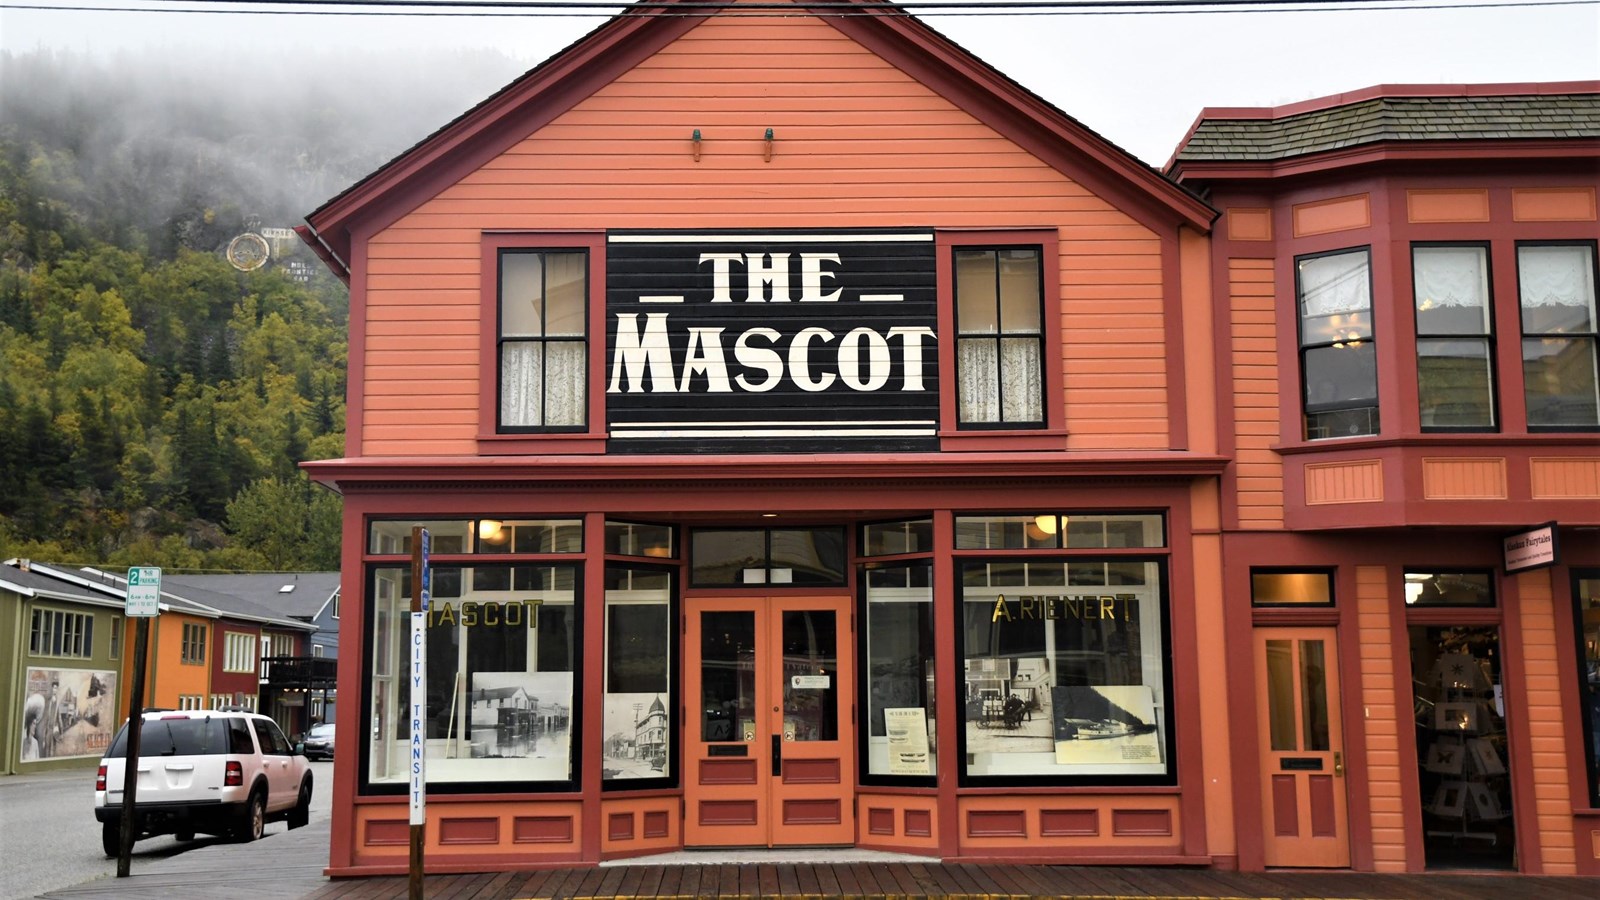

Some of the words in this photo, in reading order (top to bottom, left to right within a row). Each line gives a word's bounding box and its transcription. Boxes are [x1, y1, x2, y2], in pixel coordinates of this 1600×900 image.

[698, 252, 844, 303] THE
[606, 312, 938, 393] MASCOT
[1526, 535, 1551, 547] Fairytales
[130, 571, 138, 584] 2
[413, 633, 422, 688] CITY
[413, 704, 421, 804] TRANSIT
